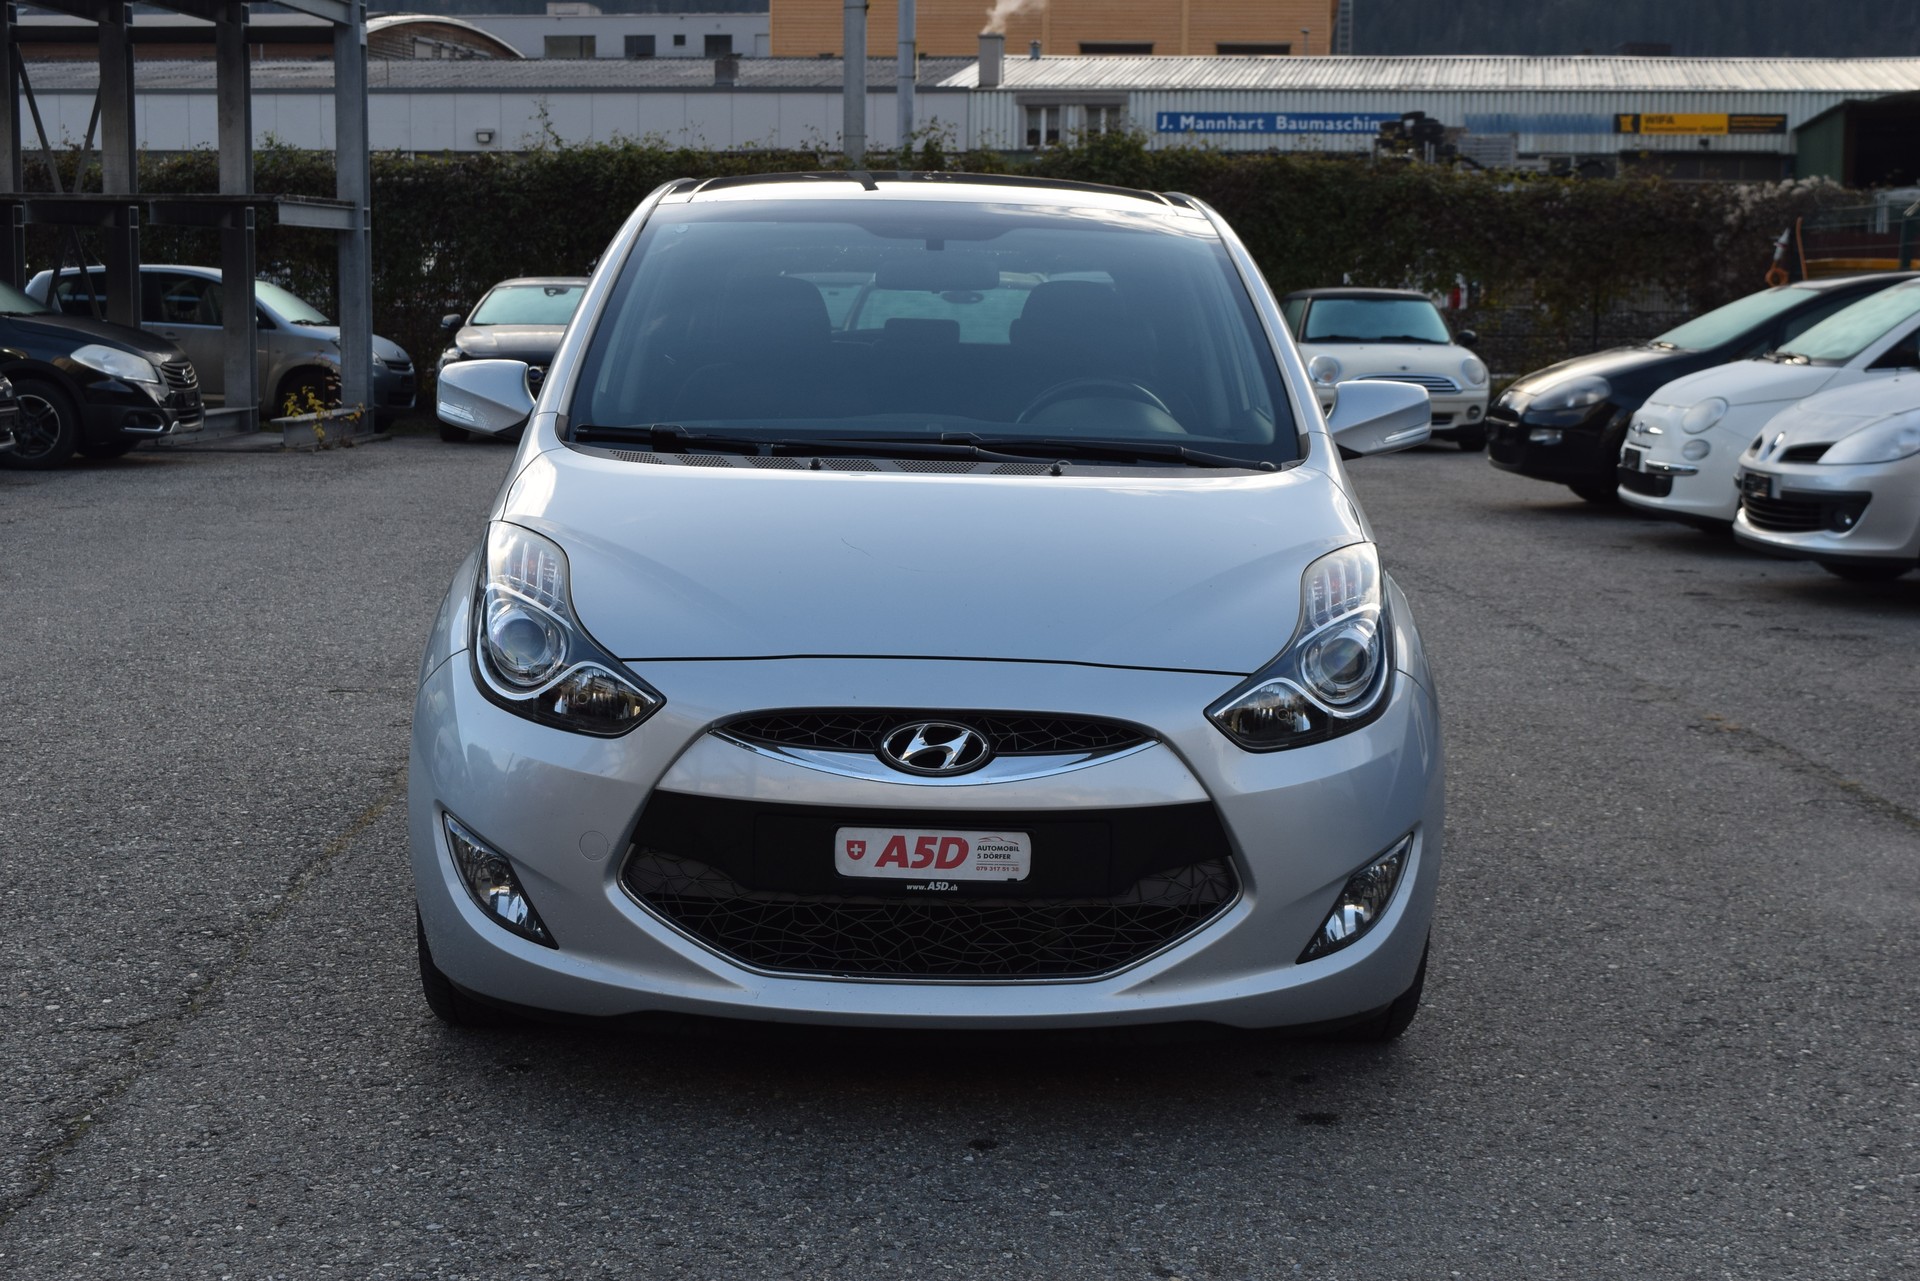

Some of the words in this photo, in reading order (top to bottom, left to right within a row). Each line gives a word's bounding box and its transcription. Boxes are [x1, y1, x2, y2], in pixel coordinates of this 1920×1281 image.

[1160, 115, 1174, 130] J.
[1180, 115, 1264, 130] Mannhart
[874, 835, 969, 869] A5D
[983, 852, 1011, 860] DÖRFER
[906, 881, 958, 891] www.A5D.ch
